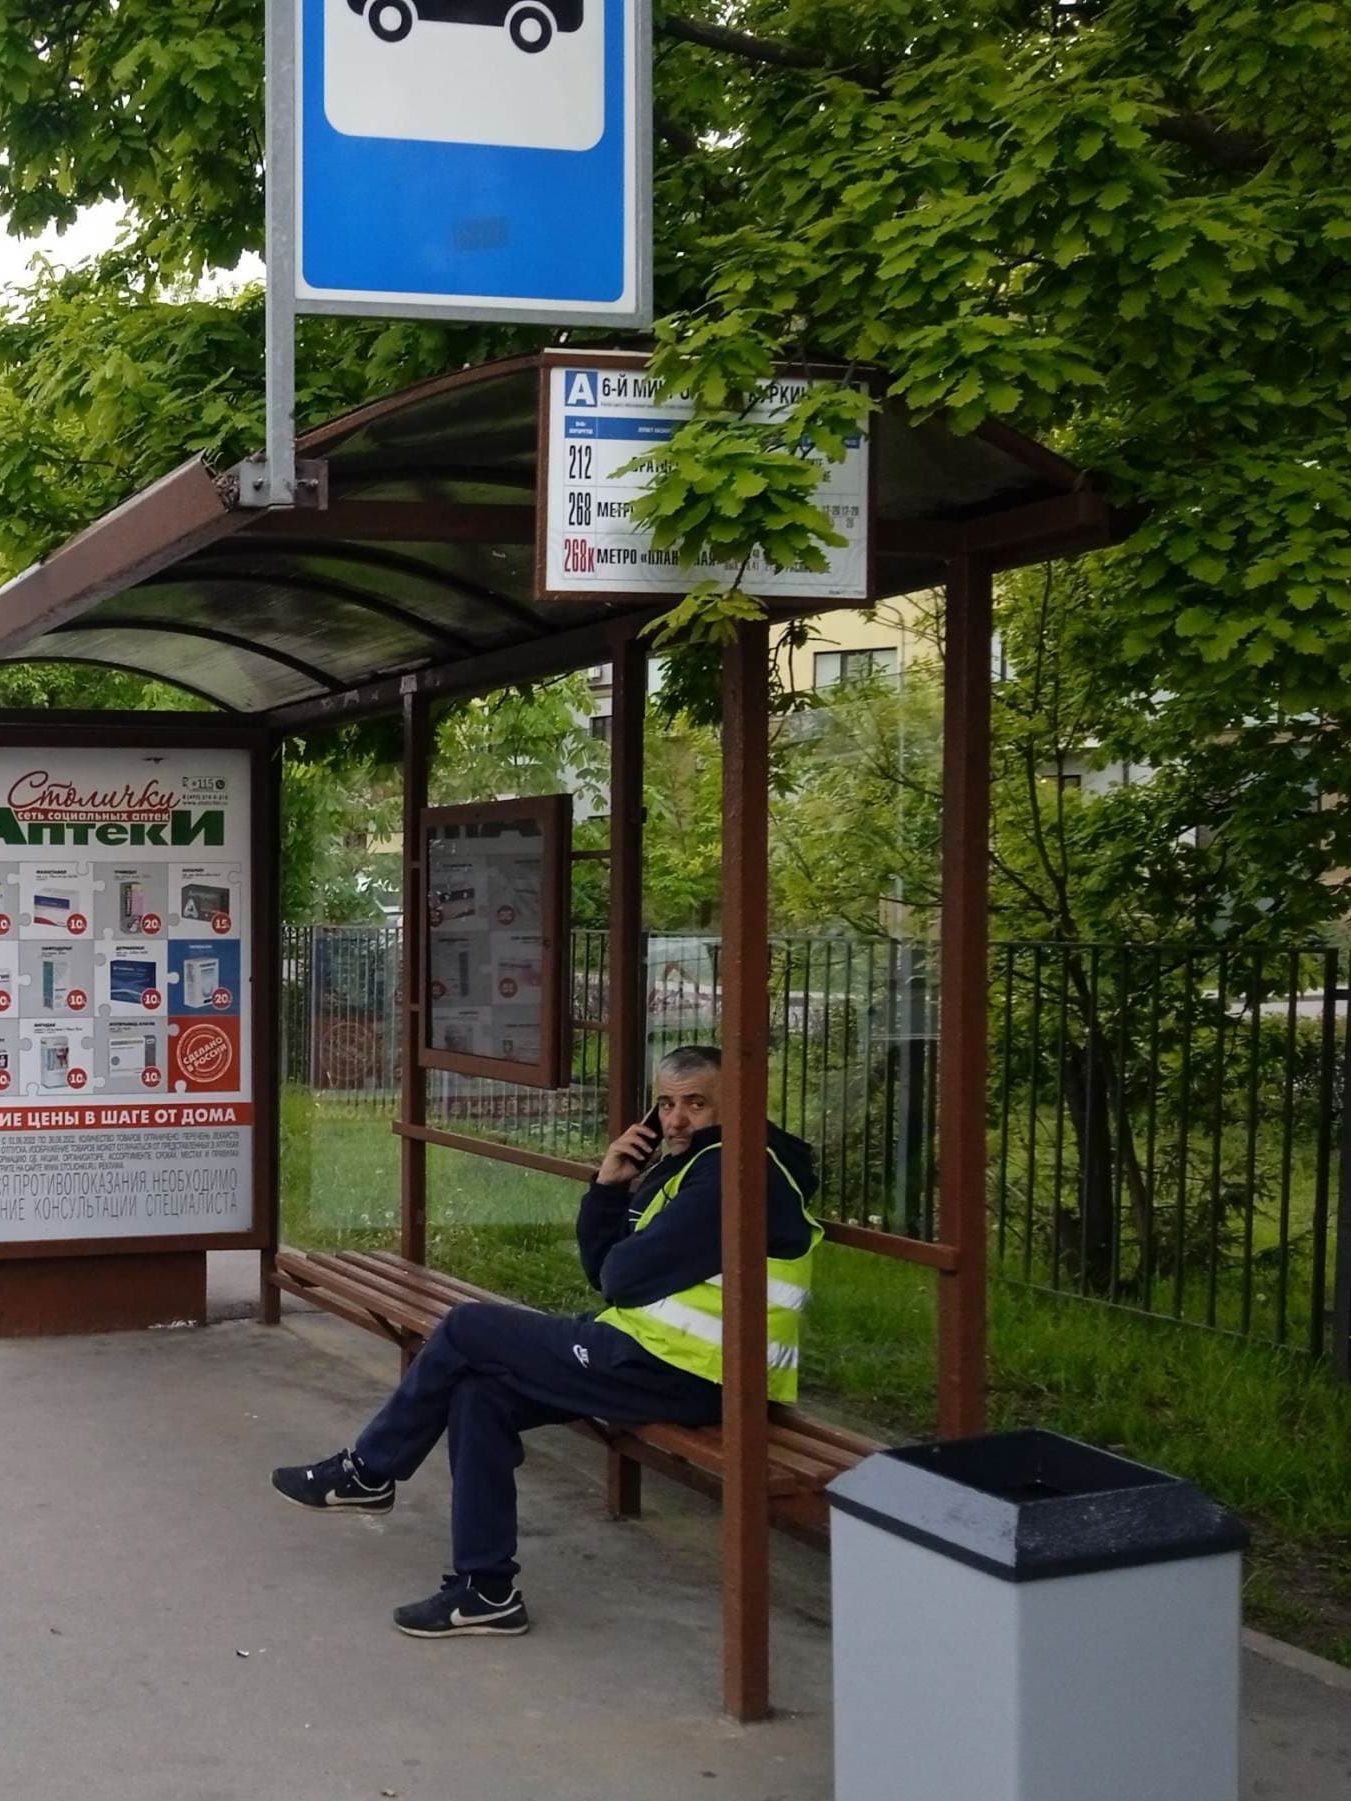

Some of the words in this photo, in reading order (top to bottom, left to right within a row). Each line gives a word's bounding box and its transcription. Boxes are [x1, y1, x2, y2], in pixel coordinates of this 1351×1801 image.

[602, 374, 628, 397] 6-Й
[569, 445, 592, 479] 212
[568, 492, 592, 526] 268
[597, 502, 634, 518] МЕТР
[597, 548, 637, 564] МЕТРО
[7, 770, 181, 809] Столички
[17, 812, 44, 821] сеть
[48, 811, 128, 823] социальных
[131, 812, 170, 821] аптек
[28, 1111, 79, 1128] ЦЕНЫ
[85, 1112, 96, 1125] В
[101, 1110, 149, 1124] ШАГЕ
[154, 1109, 177, 1123] ОТ
[181, 1108, 237, 1124] ДОМА
[153, 1168, 238, 1193] НЕОБХОДИМО
[35, 1195, 137, 1221] КОНСУЛЬТАЦИИ
[146, 1191, 237, 1218] СПЕЦИАЛИСТА
